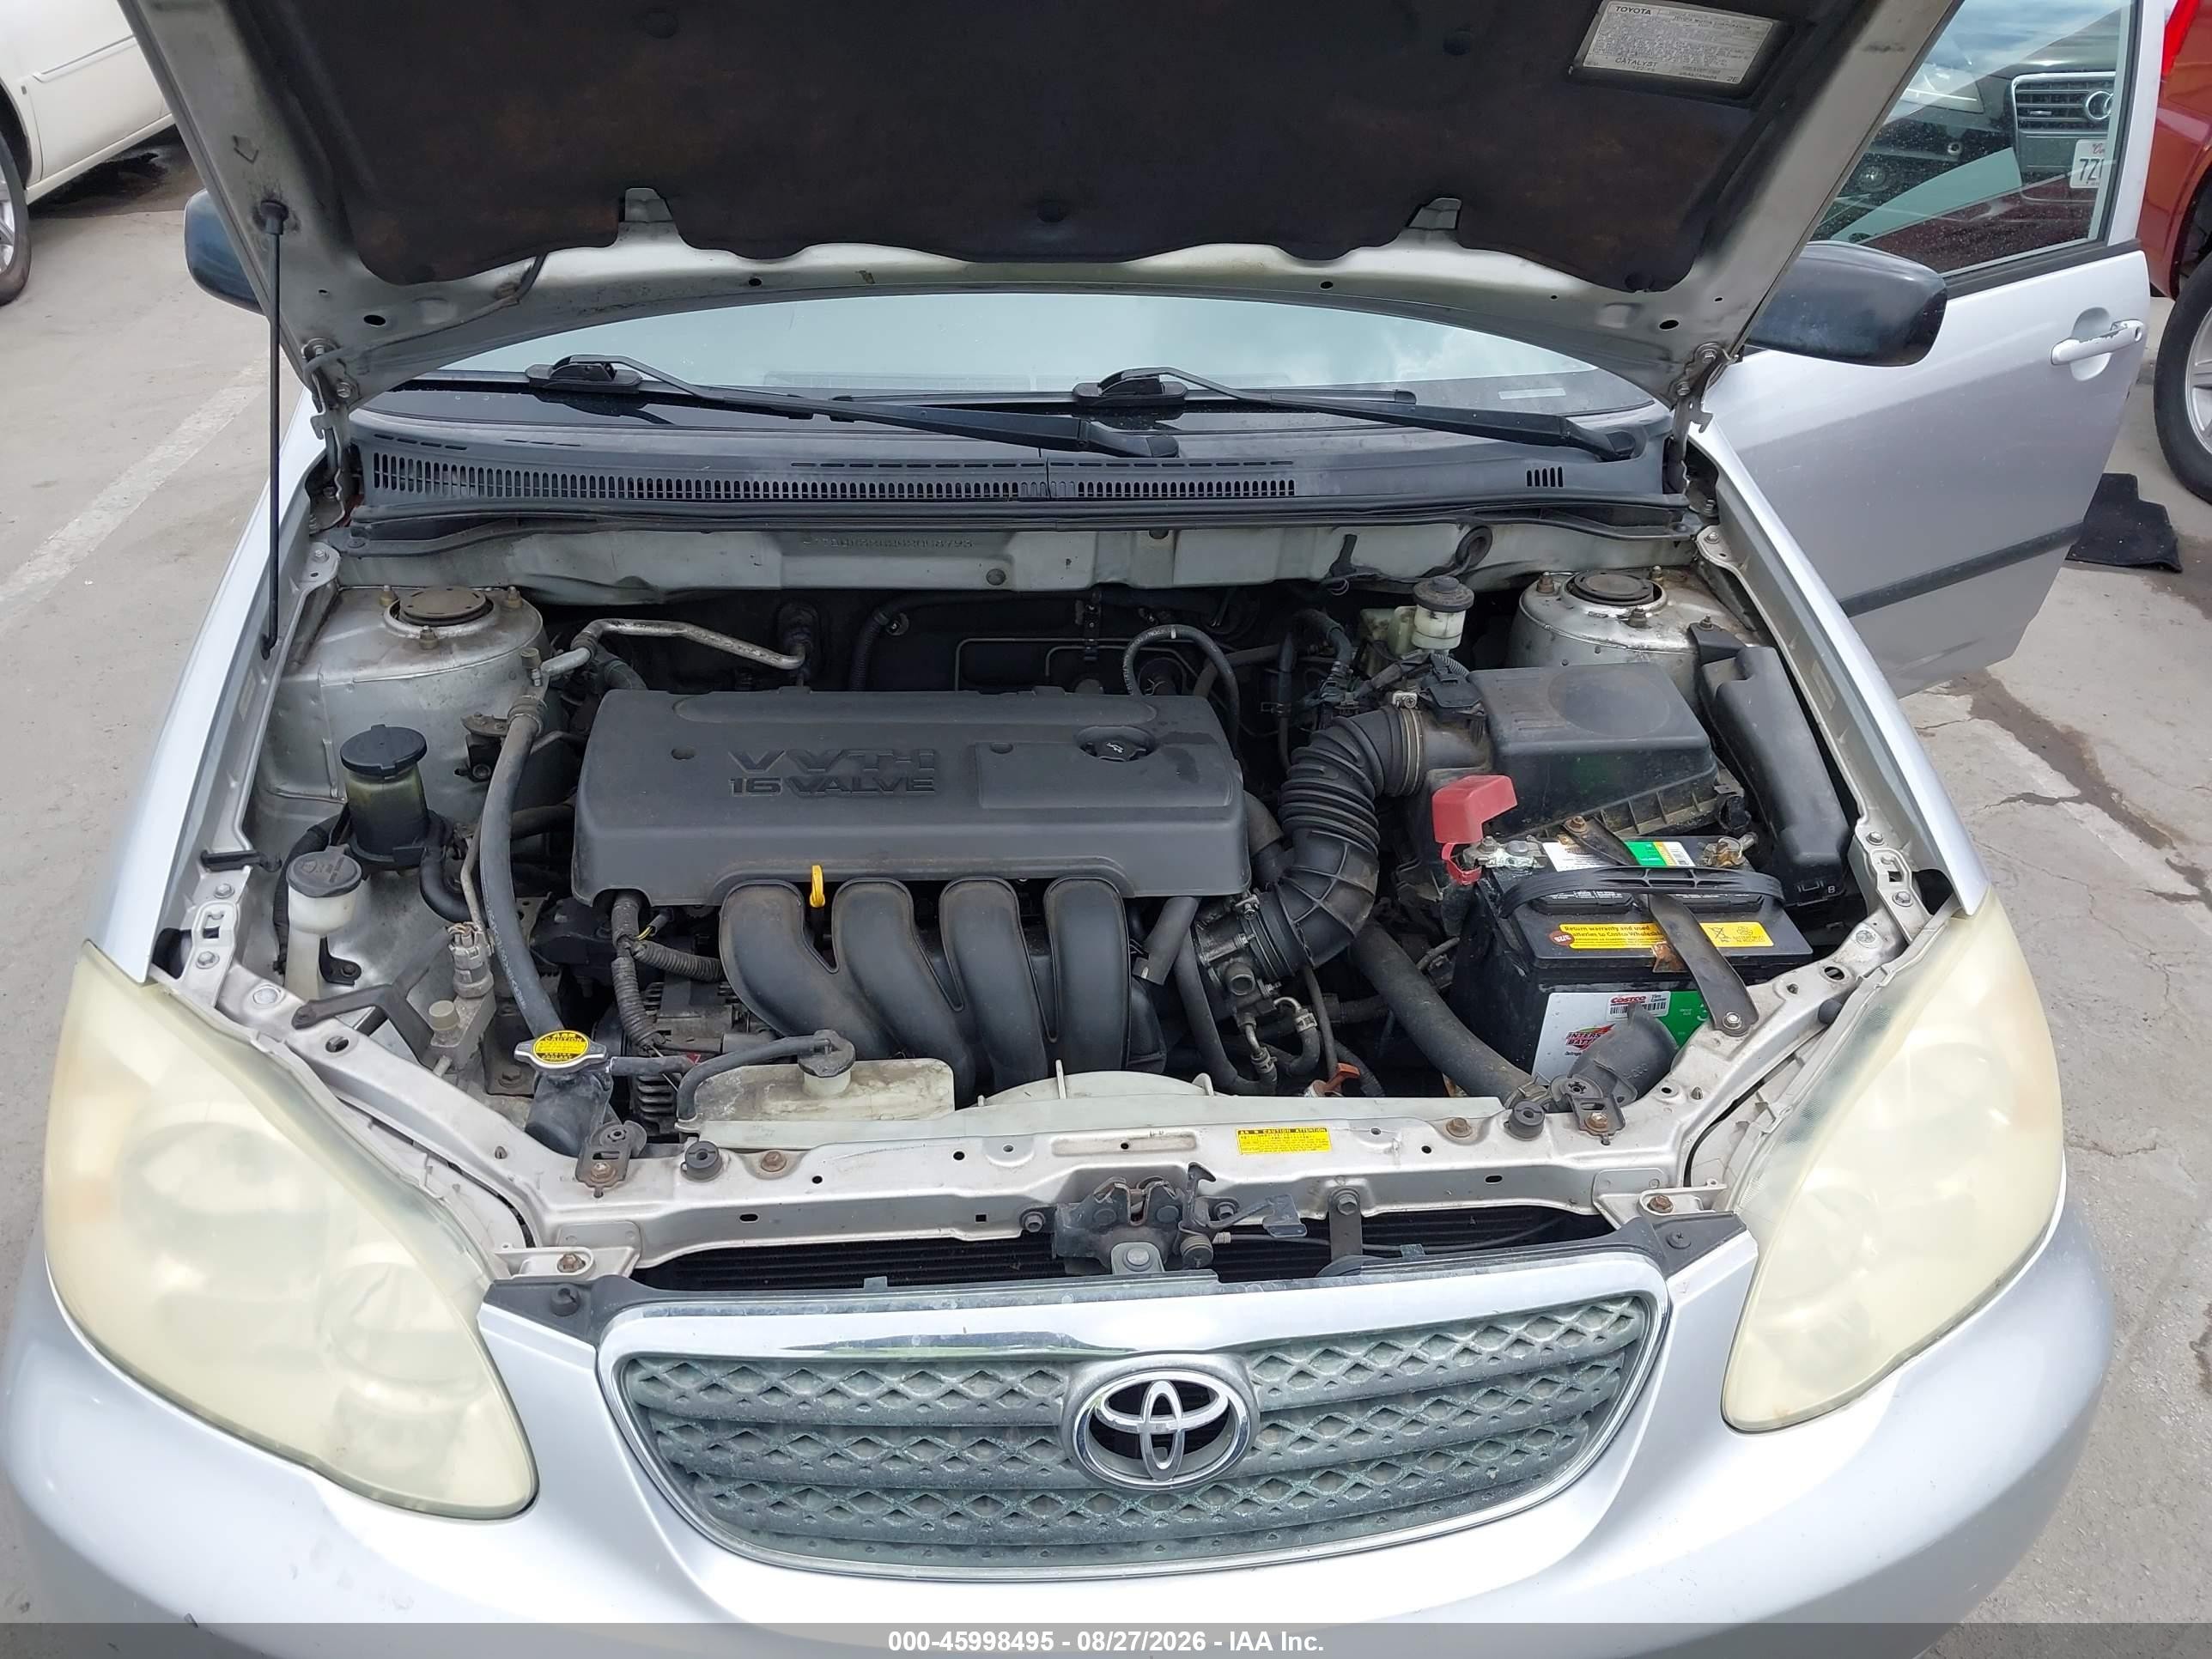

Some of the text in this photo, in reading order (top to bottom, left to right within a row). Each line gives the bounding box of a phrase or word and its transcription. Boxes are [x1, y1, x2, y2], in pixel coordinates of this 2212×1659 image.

[1615, 6, 1651, 15] TOYOTA
[1614, 57, 1657, 68] CATALYST
[728, 775, 936, 799] 16 VALVE
